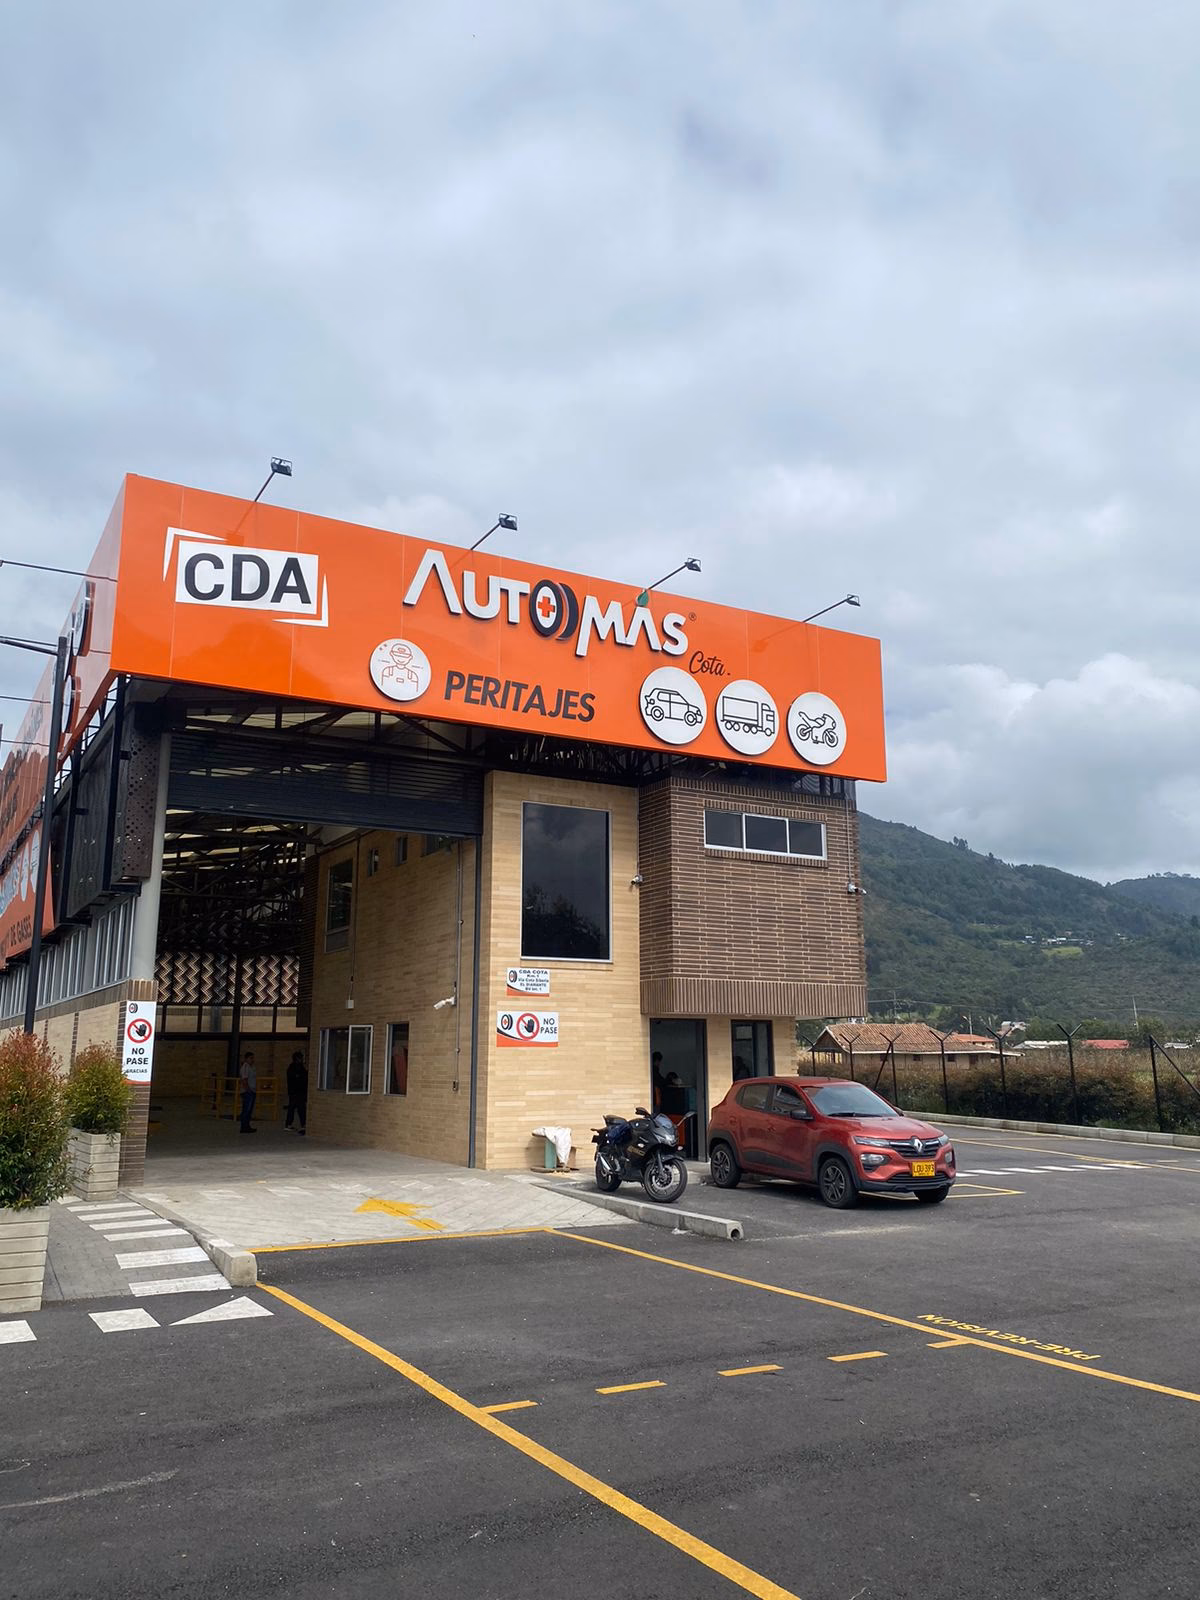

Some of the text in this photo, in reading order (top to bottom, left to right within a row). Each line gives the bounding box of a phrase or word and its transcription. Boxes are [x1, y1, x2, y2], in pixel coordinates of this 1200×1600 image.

[184, 552, 312, 604] CDA
[445, 670, 595, 723] PERITAJES
[540, 1026, 557, 1034] PASE
[131, 1047, 145, 1055] NO
[126, 1057, 149, 1065] PASE
